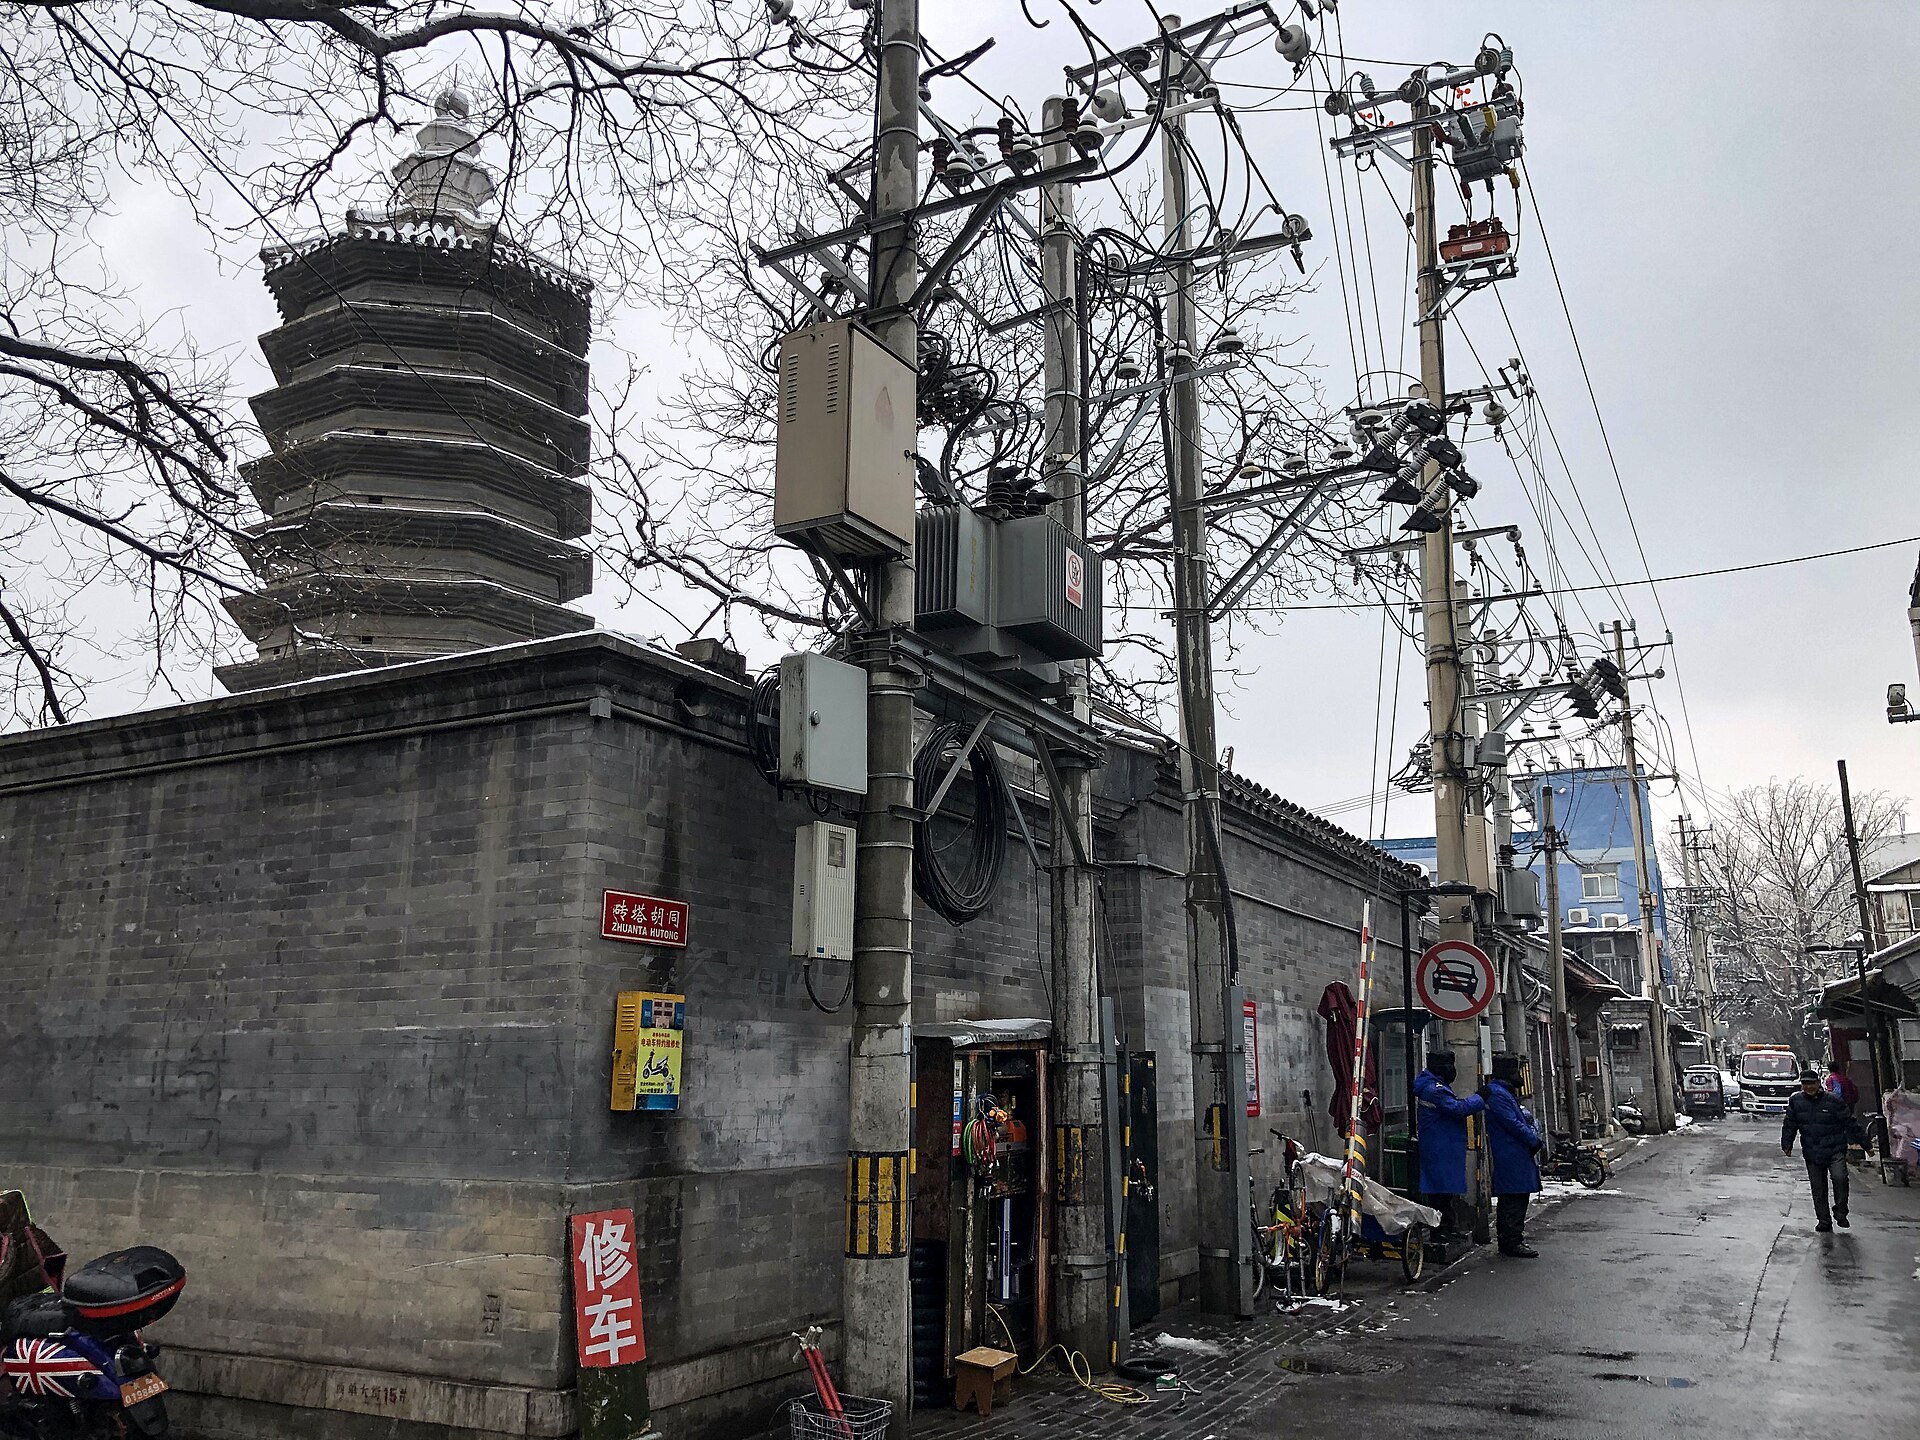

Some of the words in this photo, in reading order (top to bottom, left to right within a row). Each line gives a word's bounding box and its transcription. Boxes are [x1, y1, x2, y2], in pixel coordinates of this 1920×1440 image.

[612, 900, 680, 928] 砖塔胡同
[611, 922, 648, 936] ZHUANTA
[650, 928, 679, 940] HUTONG
[578, 1219, 637, 1365] 修车
